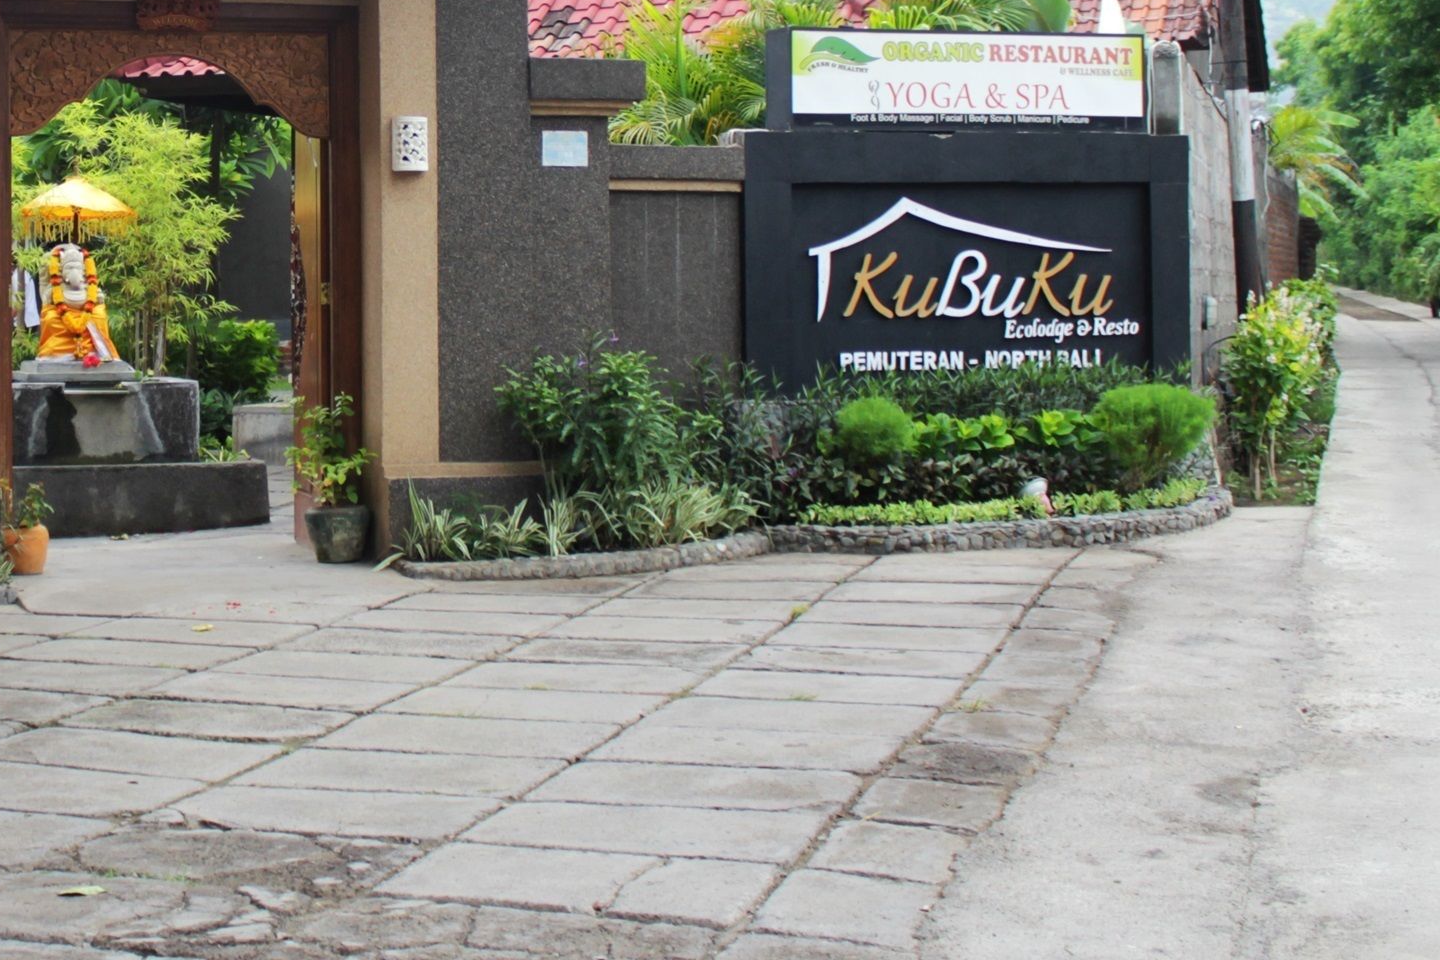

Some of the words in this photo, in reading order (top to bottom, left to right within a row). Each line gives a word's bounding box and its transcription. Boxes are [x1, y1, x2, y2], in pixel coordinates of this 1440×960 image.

[883, 41, 984, 62] ORGANIC
[989, 44, 1133, 65] RESTAURANT
[838, 64, 869, 73] HEALTHY
[1068, 67, 1111, 76] WELLNESS
[885, 81, 976, 109] YOGA
[985, 83, 1007, 109] &
[1016, 83, 1070, 110] SPA
[850, 113, 869, 122] Foot
[870, 114, 877, 122] &
[878, 113, 898, 124] Body
[900, 113, 934, 124] Massage
[940, 113, 964, 123] Facial
[968, 114, 989, 125] Body
[990, 114, 1012, 123] Scrub
[1017, 115, 1051, 124] Manicure
[1057, 115, 1090, 124] Pedicure
[843, 249, 1113, 319] KuBuKu
[1004, 317, 1073, 343] Ecolodge
[1093, 317, 1140, 336] Resto
[840, 350, 964, 371] PEMUTERAN
[985, 349, 1052, 370] NORTH
[1057, 348, 1102, 369] BALI
